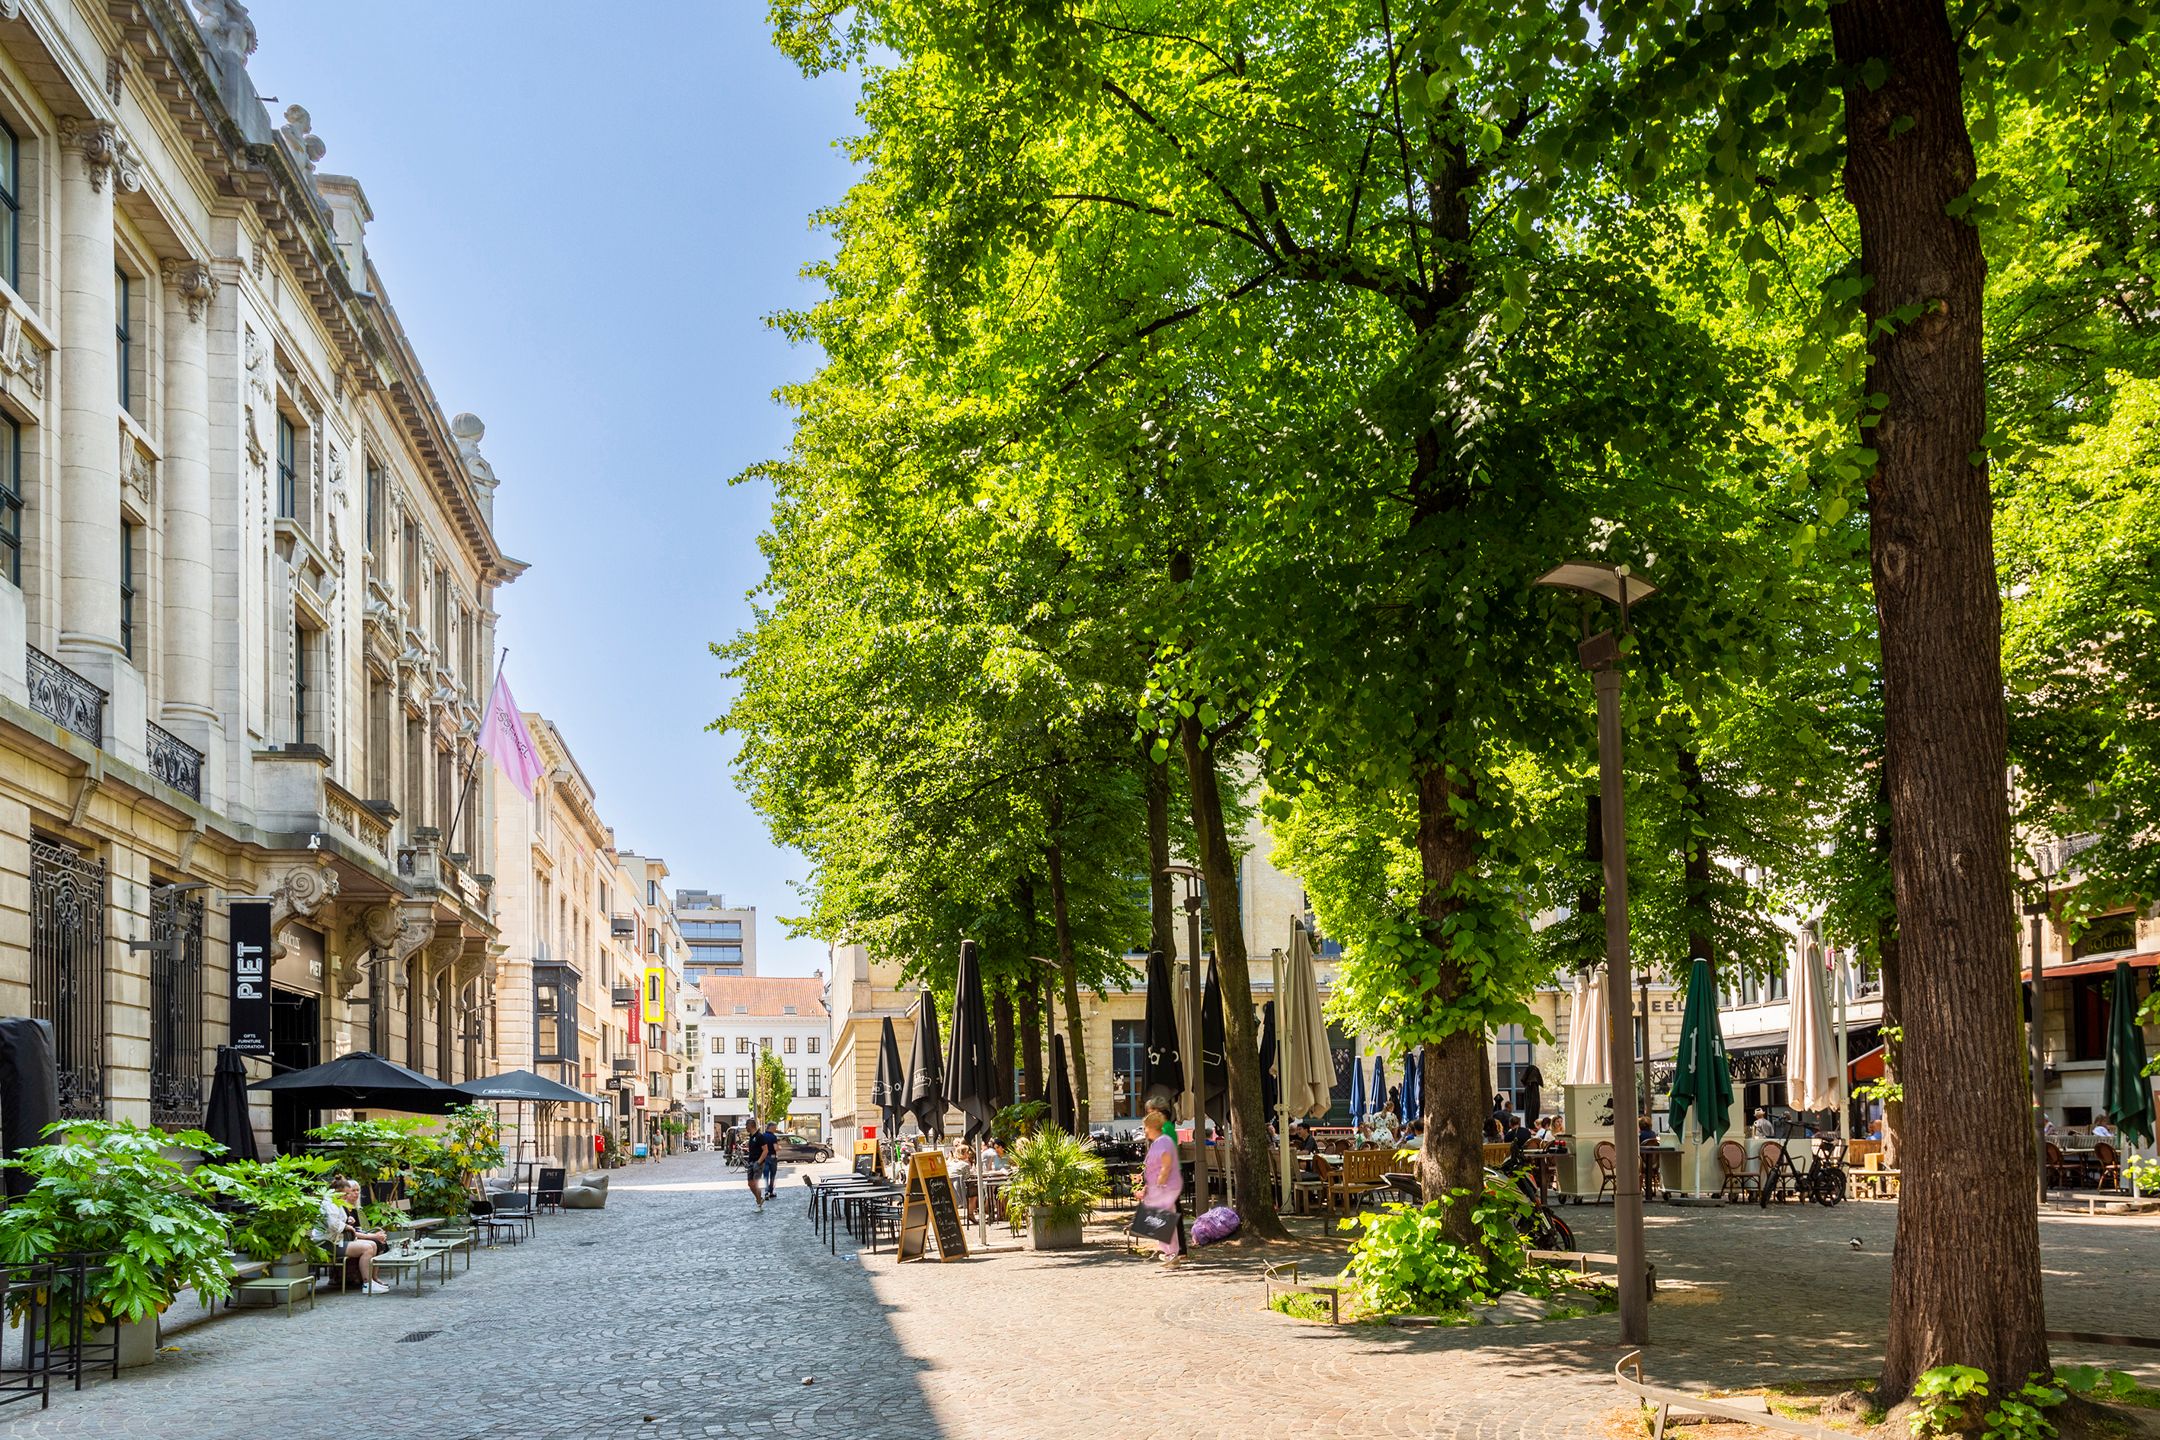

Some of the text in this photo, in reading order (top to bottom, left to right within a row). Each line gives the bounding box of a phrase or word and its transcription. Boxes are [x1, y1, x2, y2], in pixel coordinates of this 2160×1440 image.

[2087, 934, 2135, 952] BOURLA
[237, 941, 263, 999] PIET
[309, 959, 322, 977] PIET
